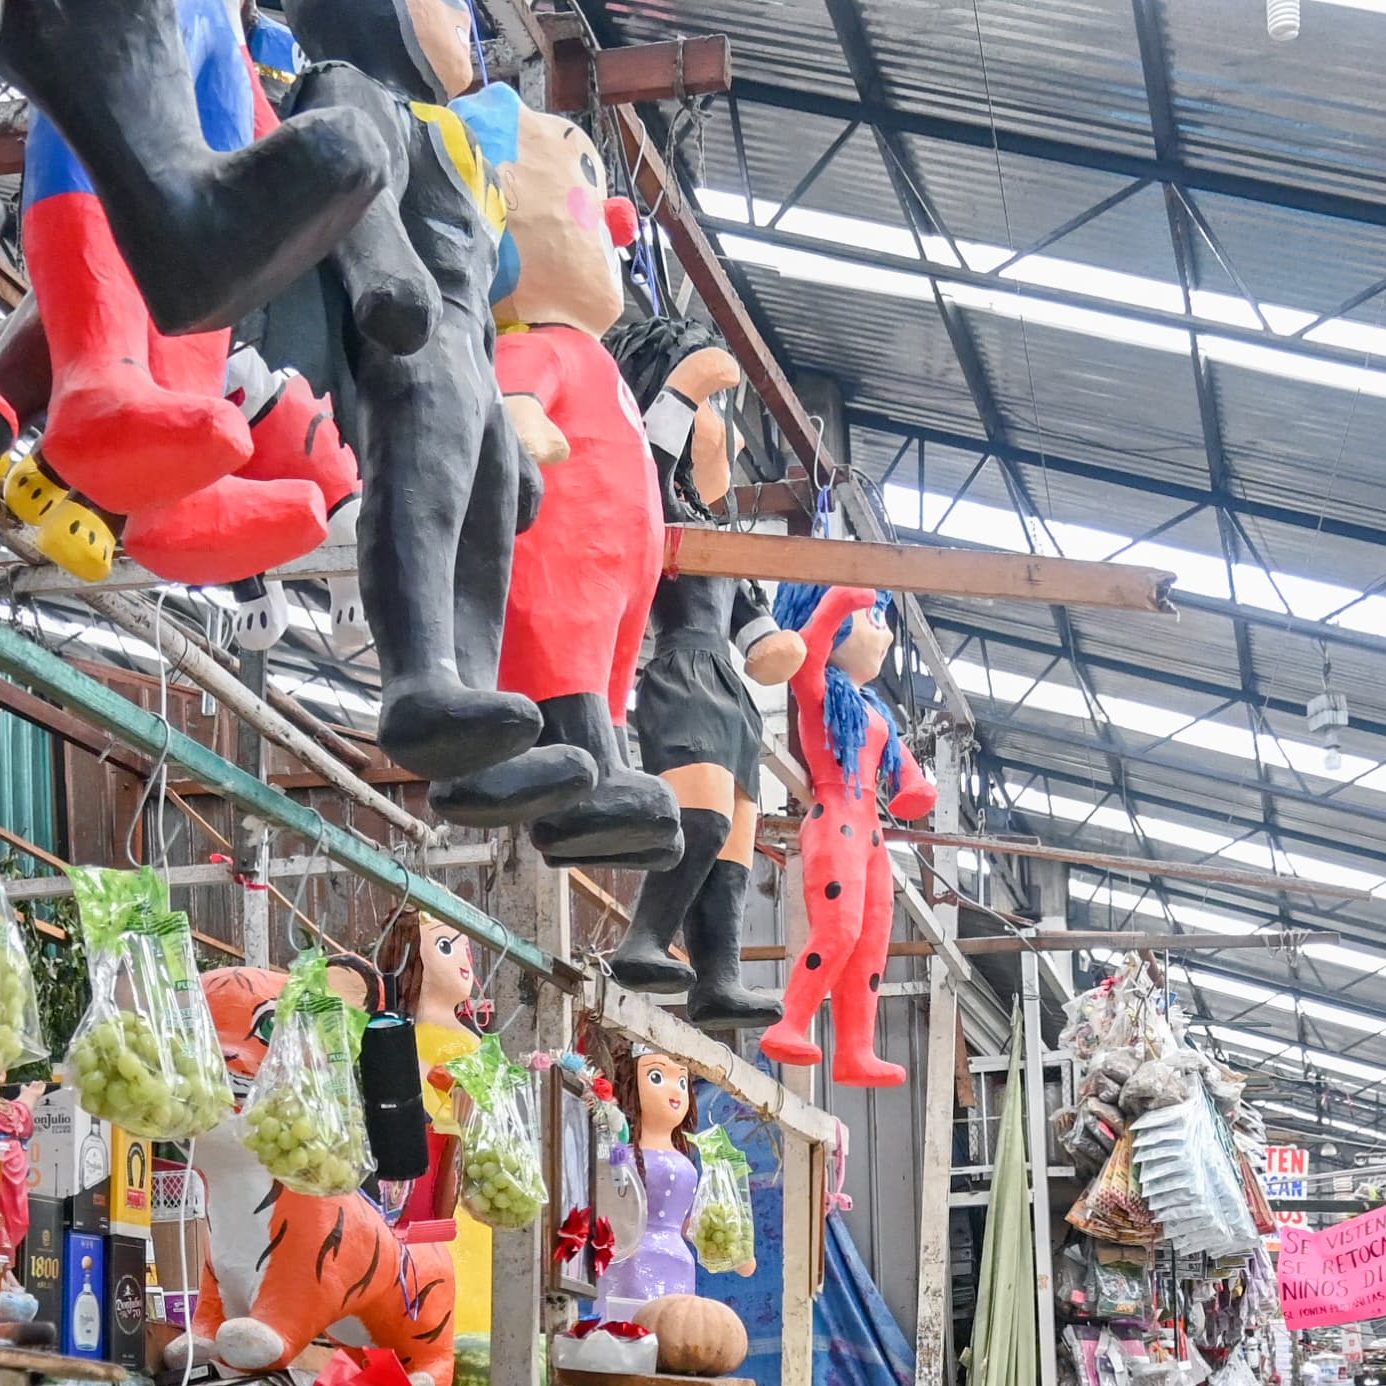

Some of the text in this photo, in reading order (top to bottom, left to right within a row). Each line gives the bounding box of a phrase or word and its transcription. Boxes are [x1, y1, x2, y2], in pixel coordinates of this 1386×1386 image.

[33, 1112, 72, 1130] onJulio
[1264, 1147, 1305, 1174] TEN
[1283, 1231, 1311, 1255] SE
[1325, 1214, 1386, 1250] VISTEN
[29, 1255, 60, 1279] 1800
[1282, 1259, 1307, 1275] SE
